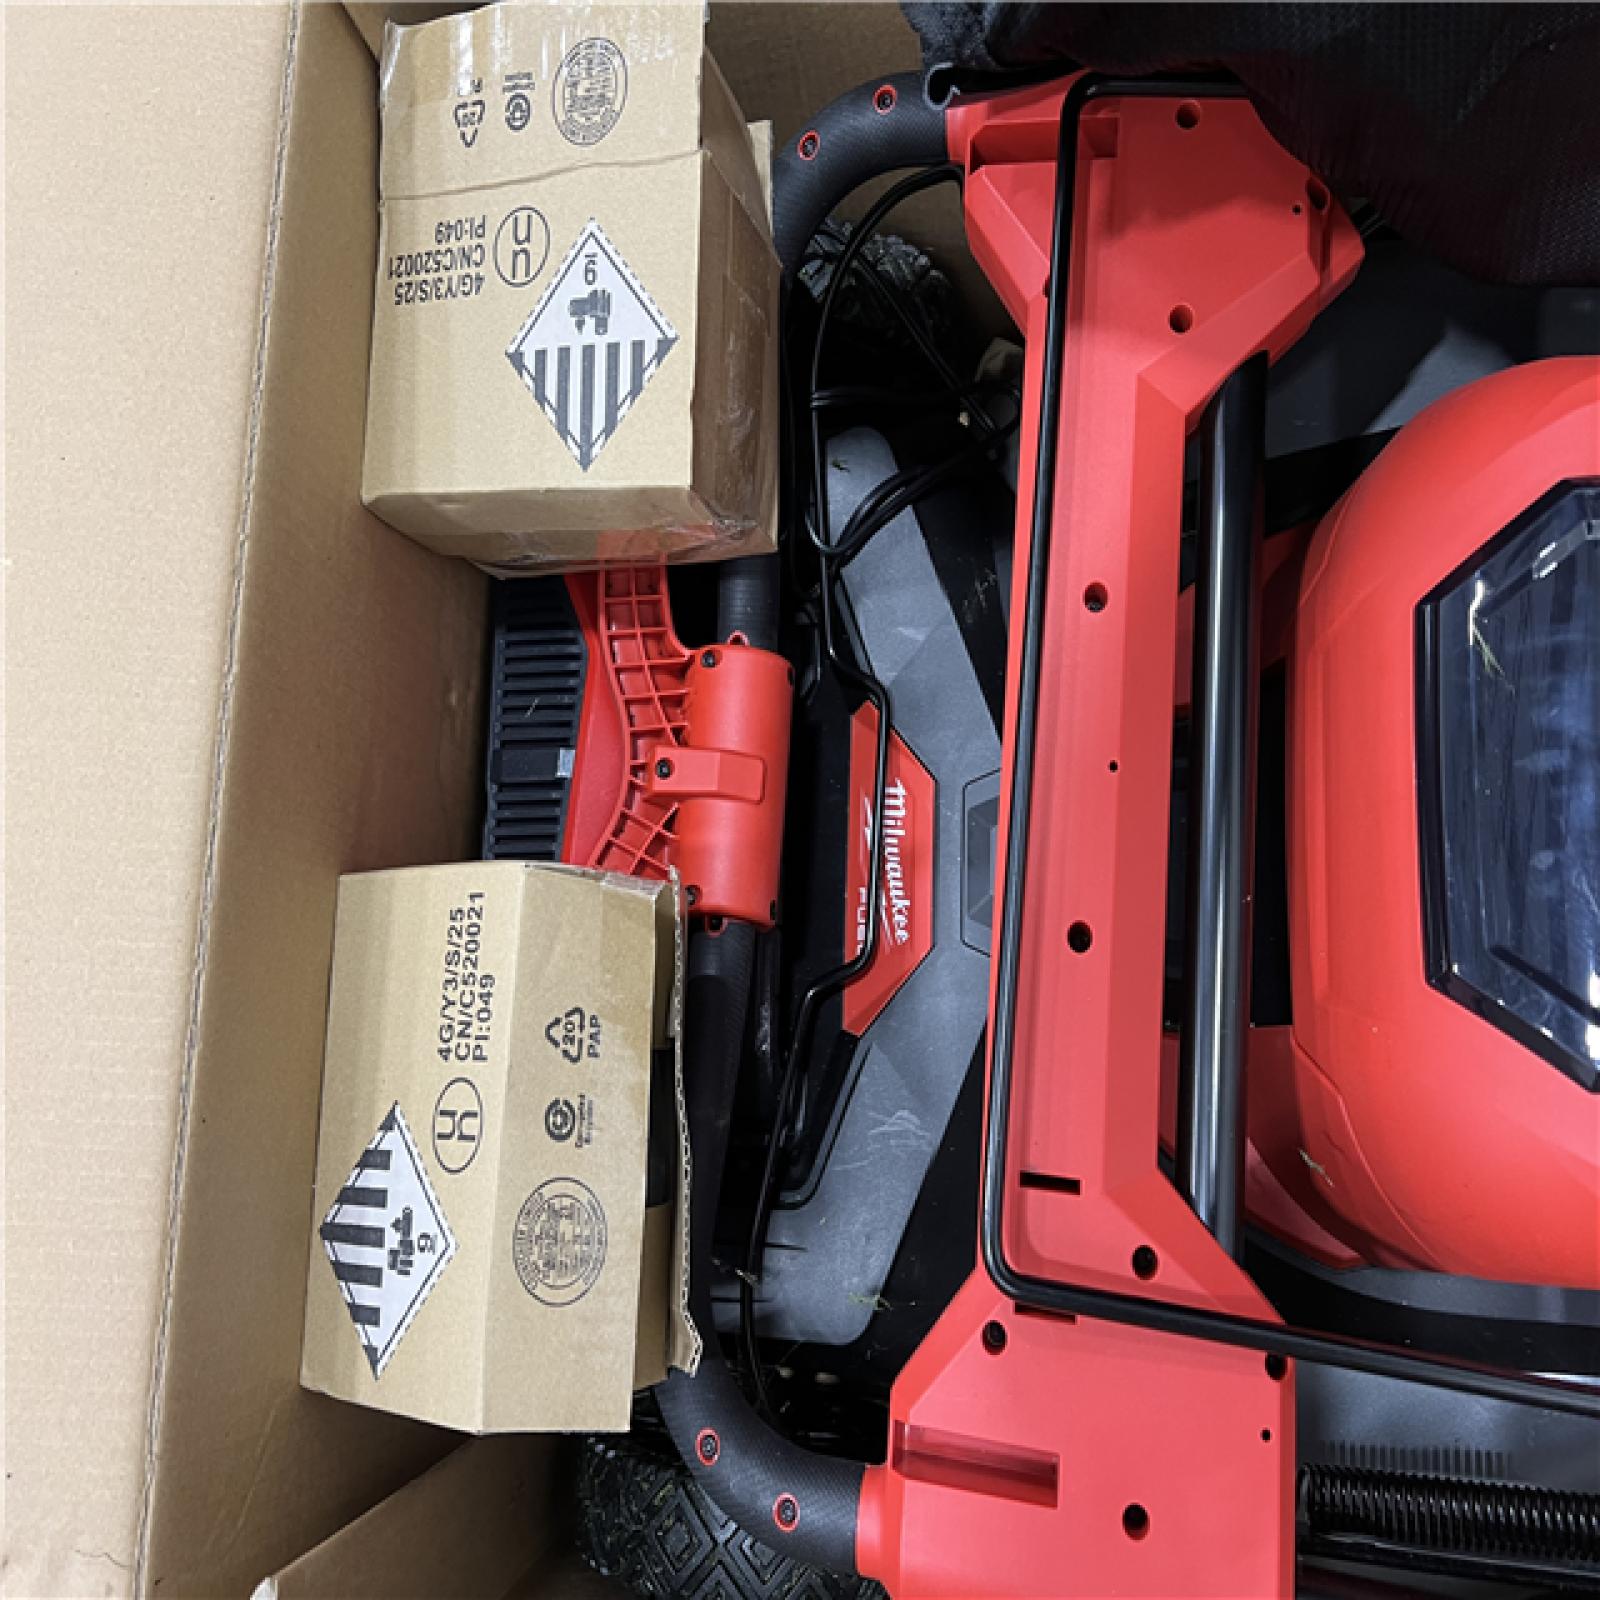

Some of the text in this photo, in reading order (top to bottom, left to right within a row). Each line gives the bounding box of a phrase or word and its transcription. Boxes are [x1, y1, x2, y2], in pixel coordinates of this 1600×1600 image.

[435, 215, 486, 244] PI:049
[388, 244, 486, 280] CN/C520021
[584, 260, 598, 285] 9
[395, 273, 486, 305] 4G/Y3/S/25
[883, 777, 911, 945] Milwaukee
[438, 906, 465, 1062] 4G/Y3/S/25
[454, 892, 485, 1061] CN/C520021
[472, 974, 495, 1062] PI:049
[562, 1020, 576, 1045] 20
[587, 1014, 601, 1058] PAP
[418, 1232, 432, 1253] 9
